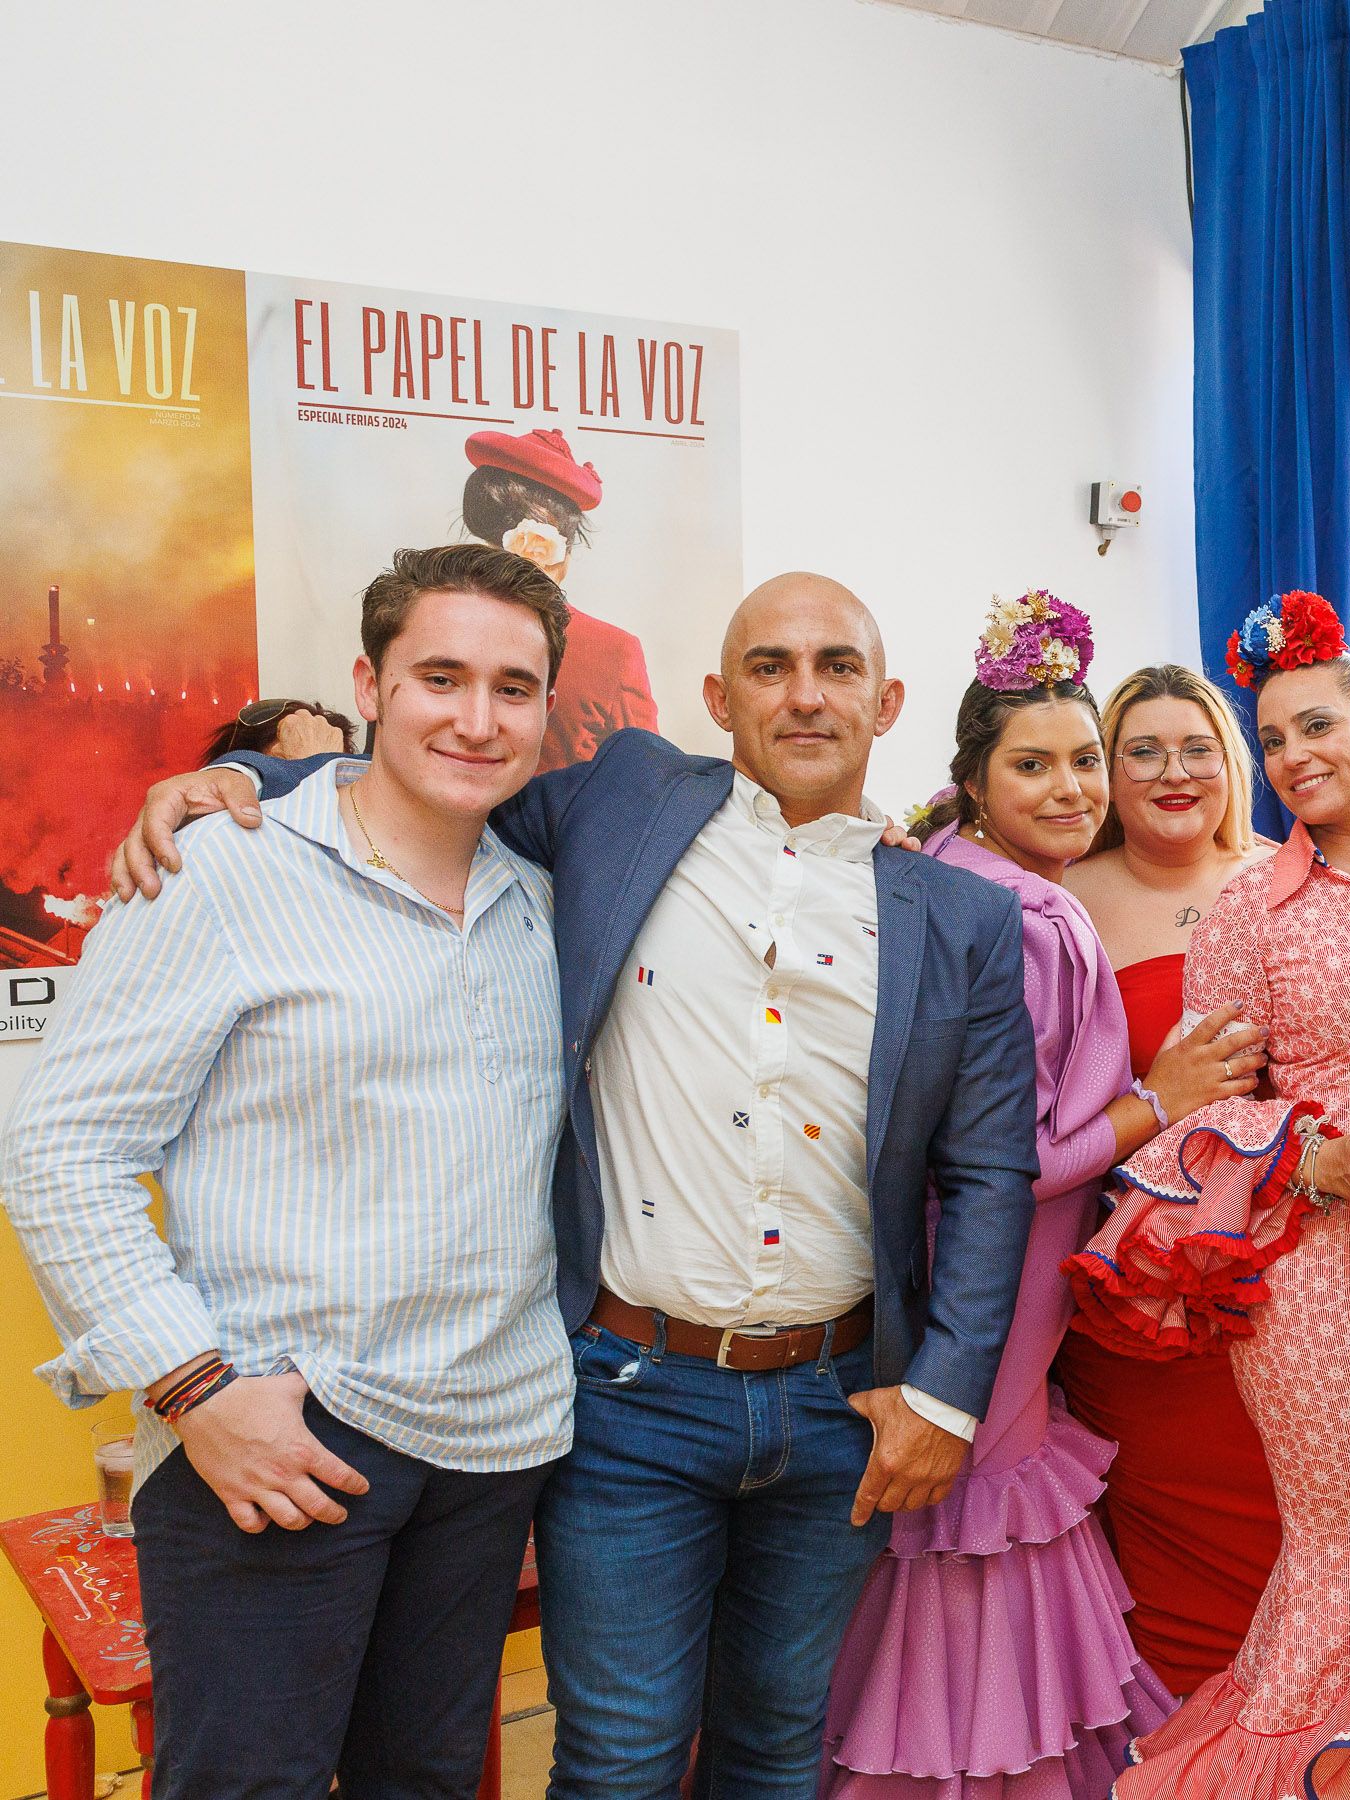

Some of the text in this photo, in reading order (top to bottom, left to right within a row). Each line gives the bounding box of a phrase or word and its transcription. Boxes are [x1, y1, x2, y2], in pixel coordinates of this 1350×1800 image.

[29, 290, 88, 391] LA
[109, 299, 201, 401] VOZ
[295, 299, 705, 426] EL PAPEL DE LA VOZ
[298, 409, 408, 430] ESPECIAL FERIAS 2024
